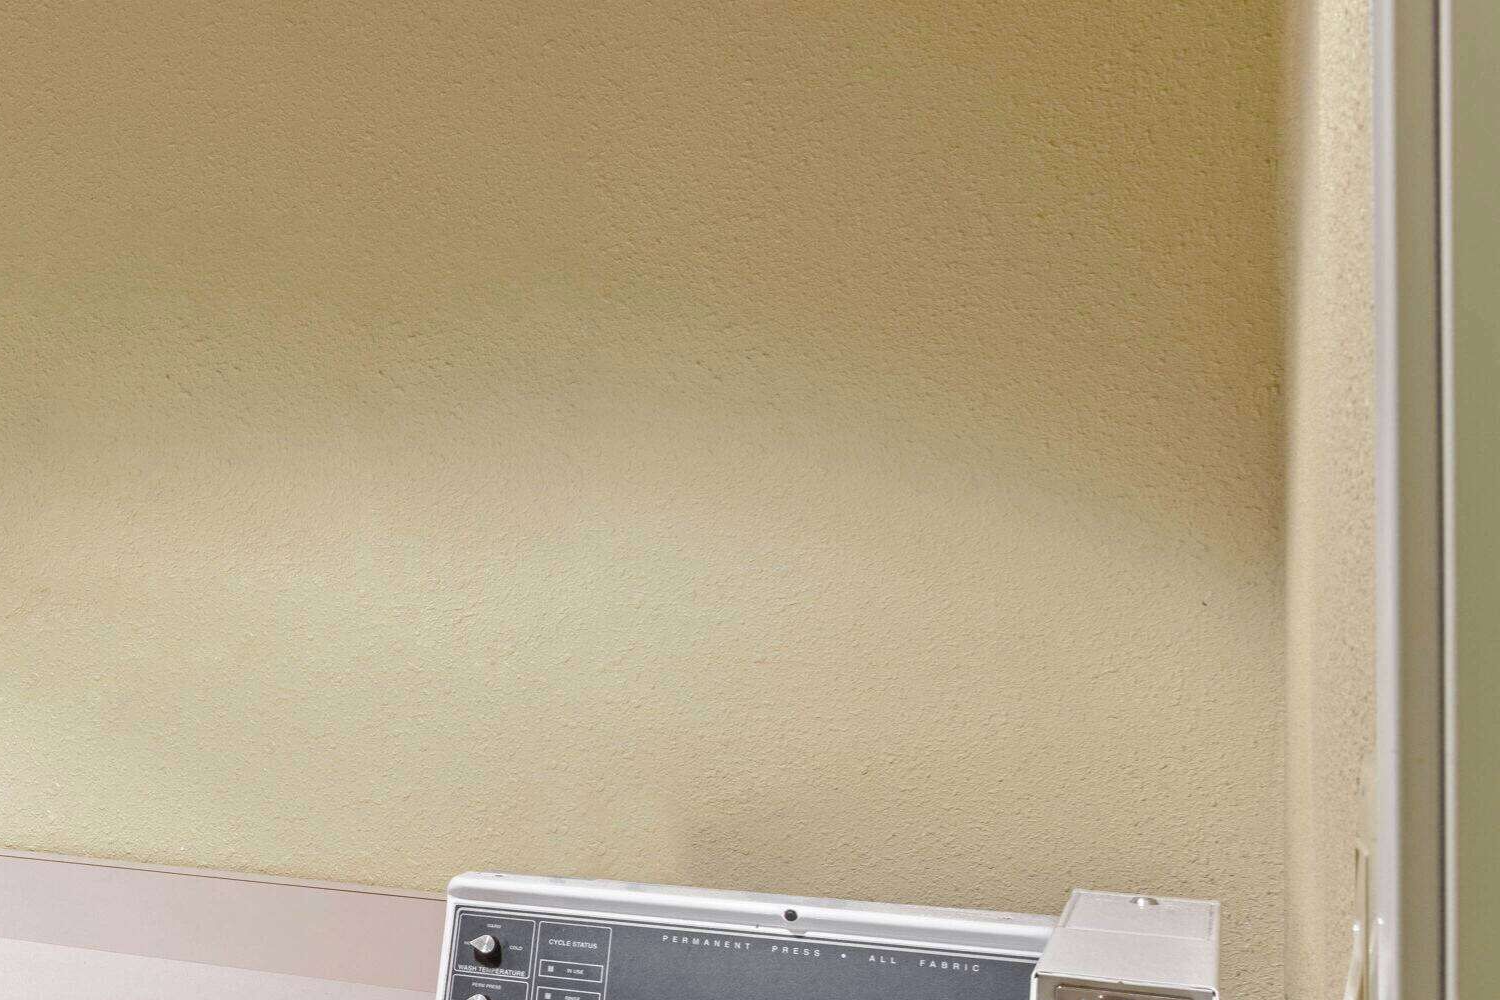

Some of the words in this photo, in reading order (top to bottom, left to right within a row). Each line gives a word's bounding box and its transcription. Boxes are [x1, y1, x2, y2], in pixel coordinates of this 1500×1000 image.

[548, 938, 571, 947] CYCLE
[572, 941, 598, 949] STATUS
[662, 935, 751, 950] PERMANENT
[771, 945, 821, 957] PRESS
[868, 955, 897, 965] ALL
[919, 959, 981, 972] FABRIC
[457, 964, 477, 972] WASH
[478, 966, 526, 976] TEMPERATURE
